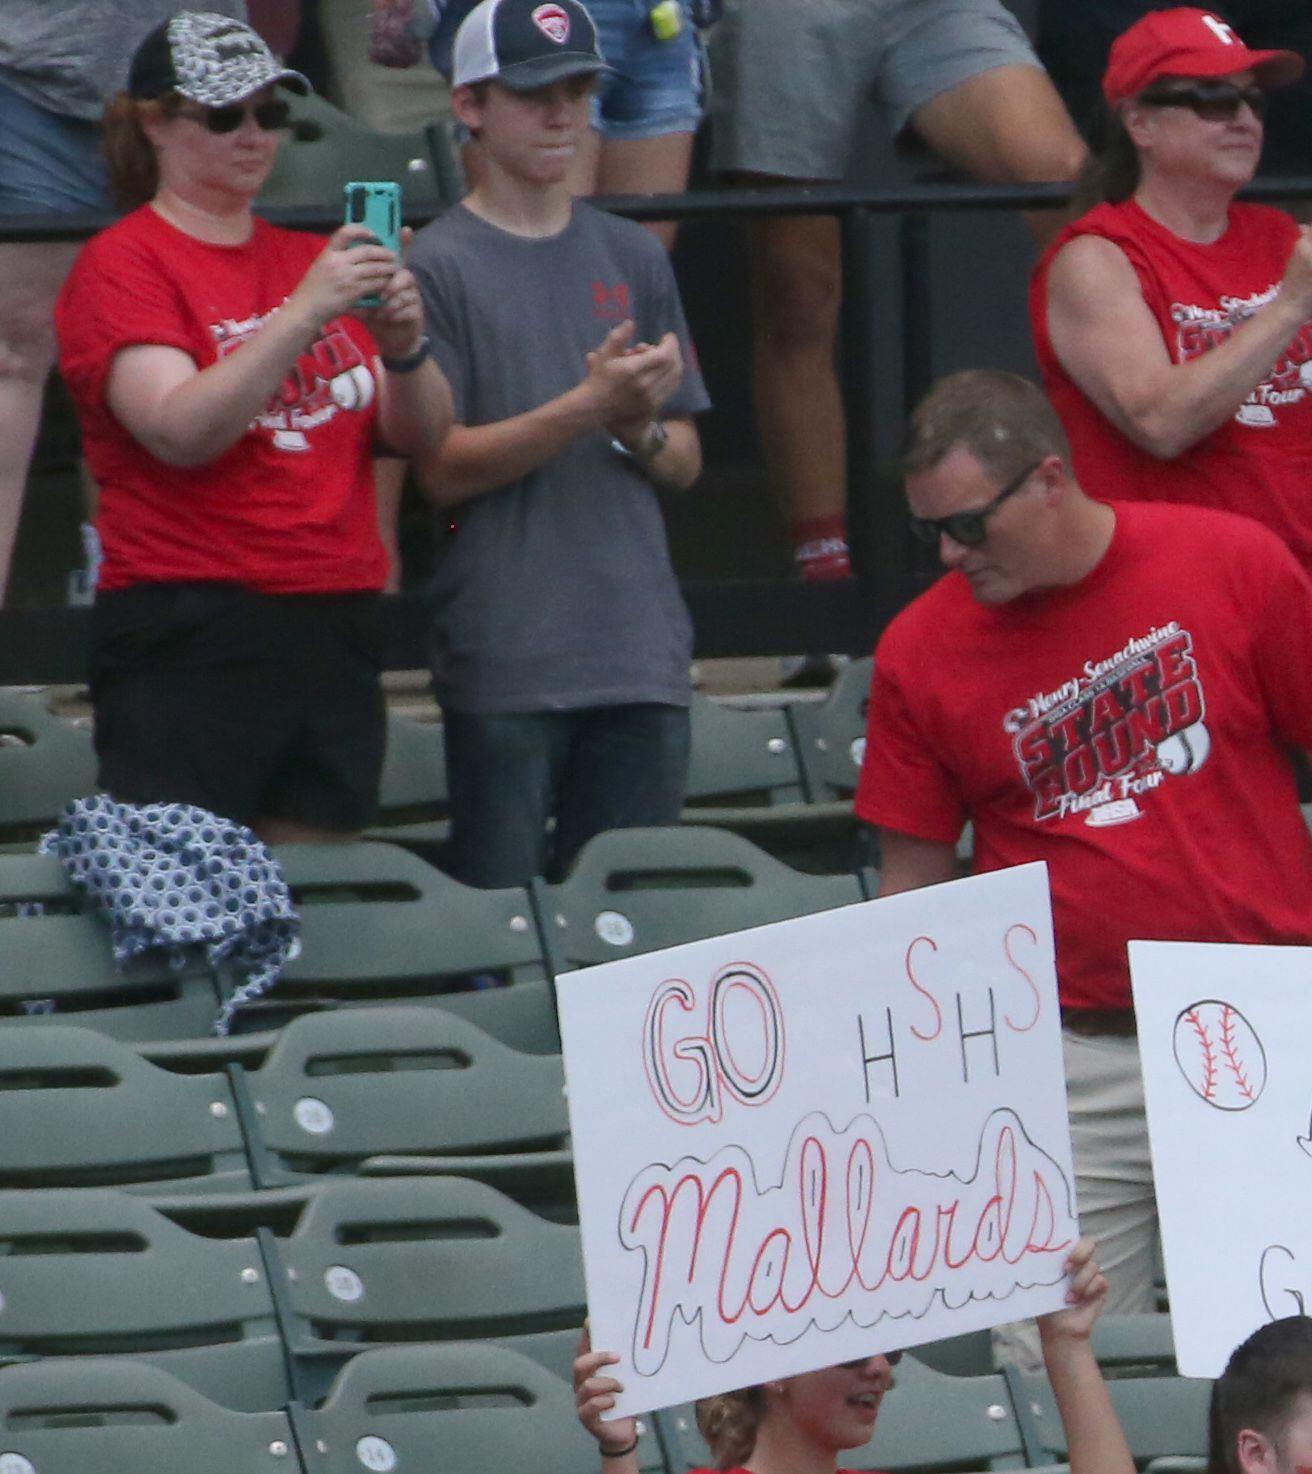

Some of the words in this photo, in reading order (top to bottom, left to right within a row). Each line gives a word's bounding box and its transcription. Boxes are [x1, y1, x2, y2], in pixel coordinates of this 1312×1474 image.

[1016, 631, 1193, 766] STATE
[1029, 679, 1205, 820] BOUND
[1059, 781, 1111, 818] Final
[1119, 768, 1165, 798] Four
[643, 961, 786, 1126] GO
[857, 923, 1041, 1104] HSHS
[630, 1126, 1072, 1349] Mallards
